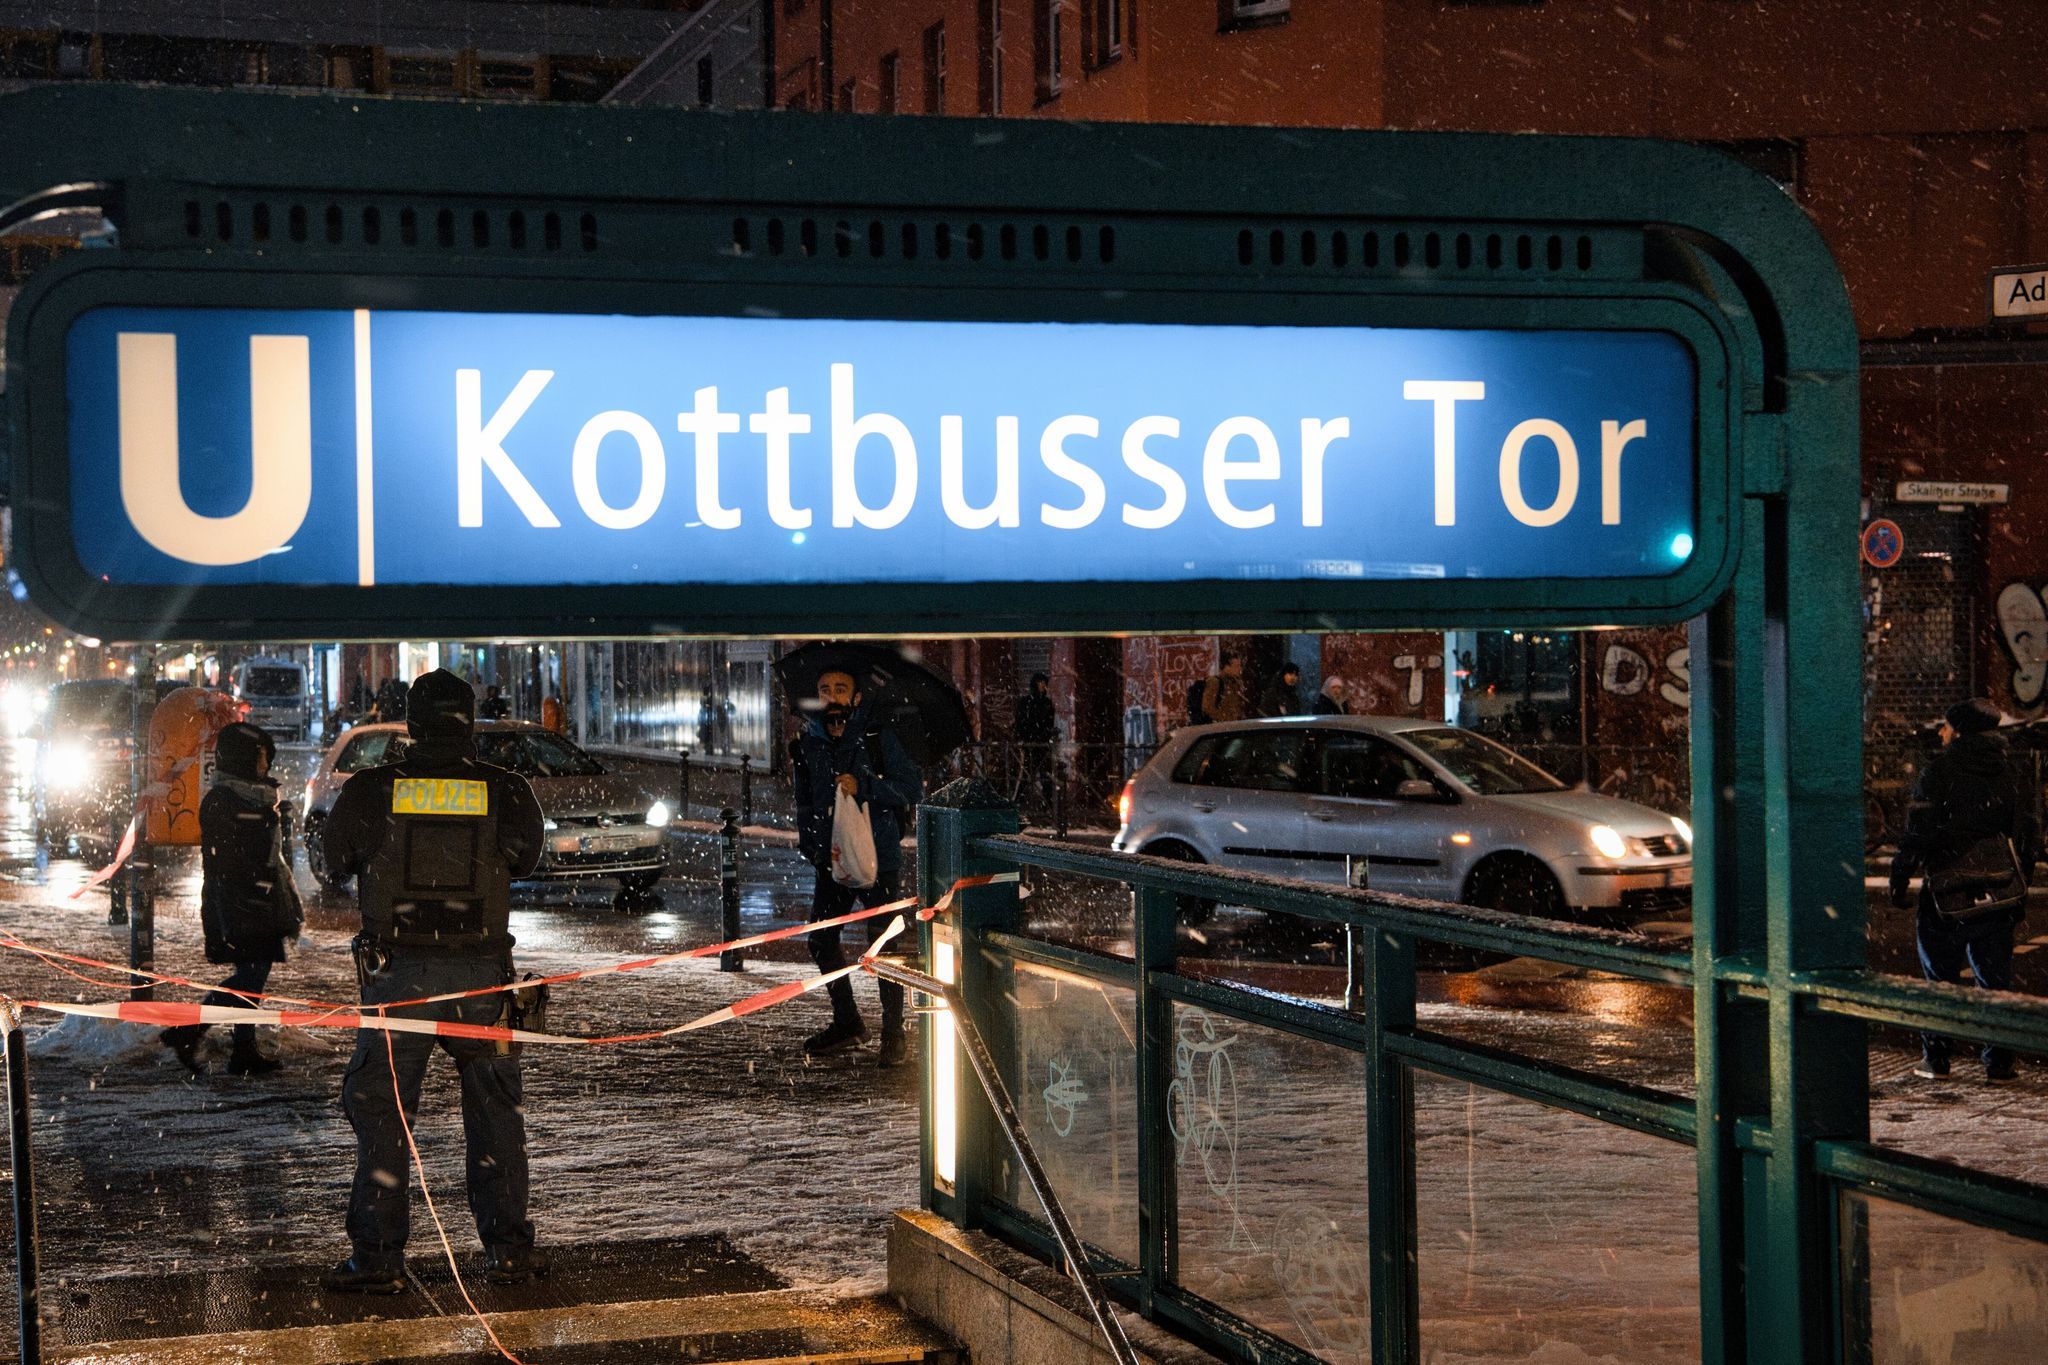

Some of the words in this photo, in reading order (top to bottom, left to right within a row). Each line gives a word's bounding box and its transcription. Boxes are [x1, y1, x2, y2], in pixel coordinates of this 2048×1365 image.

[116, 332, 313, 566] U
[455, 362, 1351, 530] Kottbusser
[1403, 380, 1647, 527] Tor
[395, 781, 485, 812] POLIZEI
